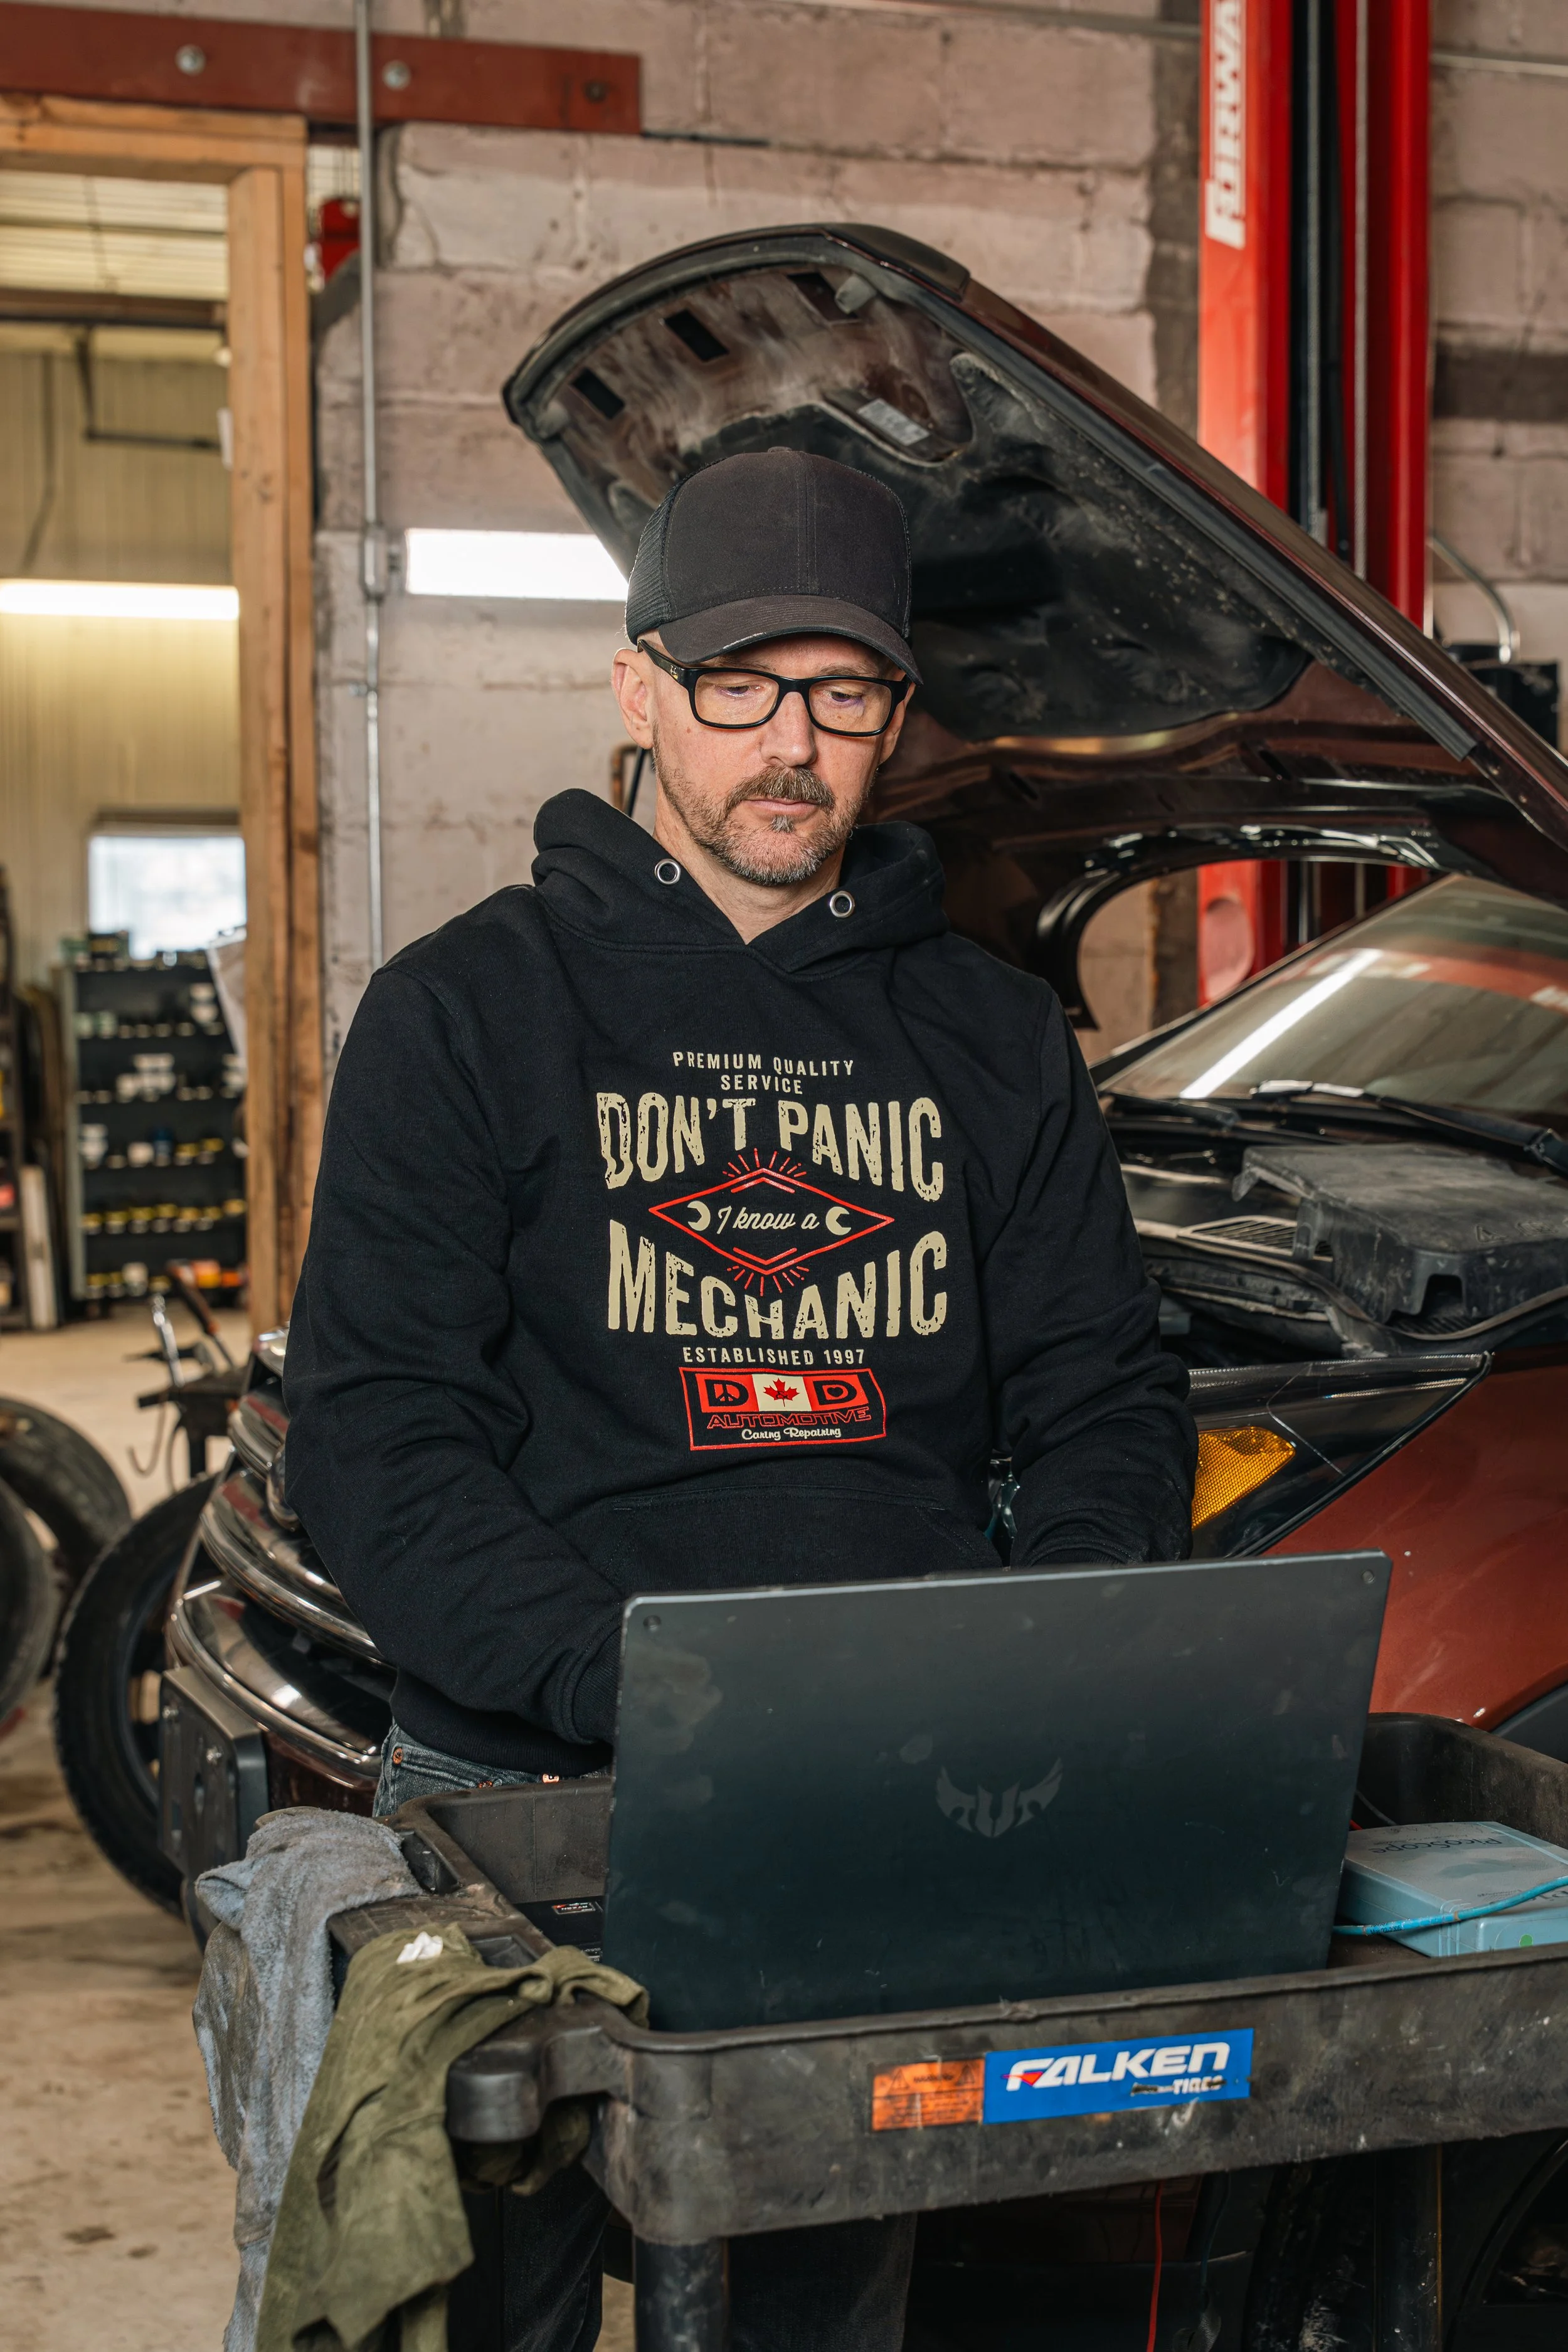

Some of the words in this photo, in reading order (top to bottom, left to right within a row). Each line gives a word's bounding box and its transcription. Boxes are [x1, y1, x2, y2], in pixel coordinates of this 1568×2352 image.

[673, 1051, 761, 1069] PREMIUM
[773, 1057, 854, 1076] QUALITY
[721, 1075, 803, 1094] SERVICE
[596, 1093, 756, 1190] DON'T
[778, 1097, 943, 1202] PANIC
[717, 1205, 732, 1234] I
[733, 1206, 796, 1230] know
[800, 1212, 820, 1230] a
[608, 1219, 947, 1340] MECHANIC
[683, 1347, 814, 1365] ESTABLISHED
[824, 1348, 865, 1365] 1997
[707, 1406, 872, 1429] AUTOMOTIVE
[741, 1428, 781, 1441] Caring
[783, 1427, 842, 1439] Repairing
[1369, 1836, 1503, 1853] PicoScope
[1007, 2042, 1231, 2091] FALKEN
